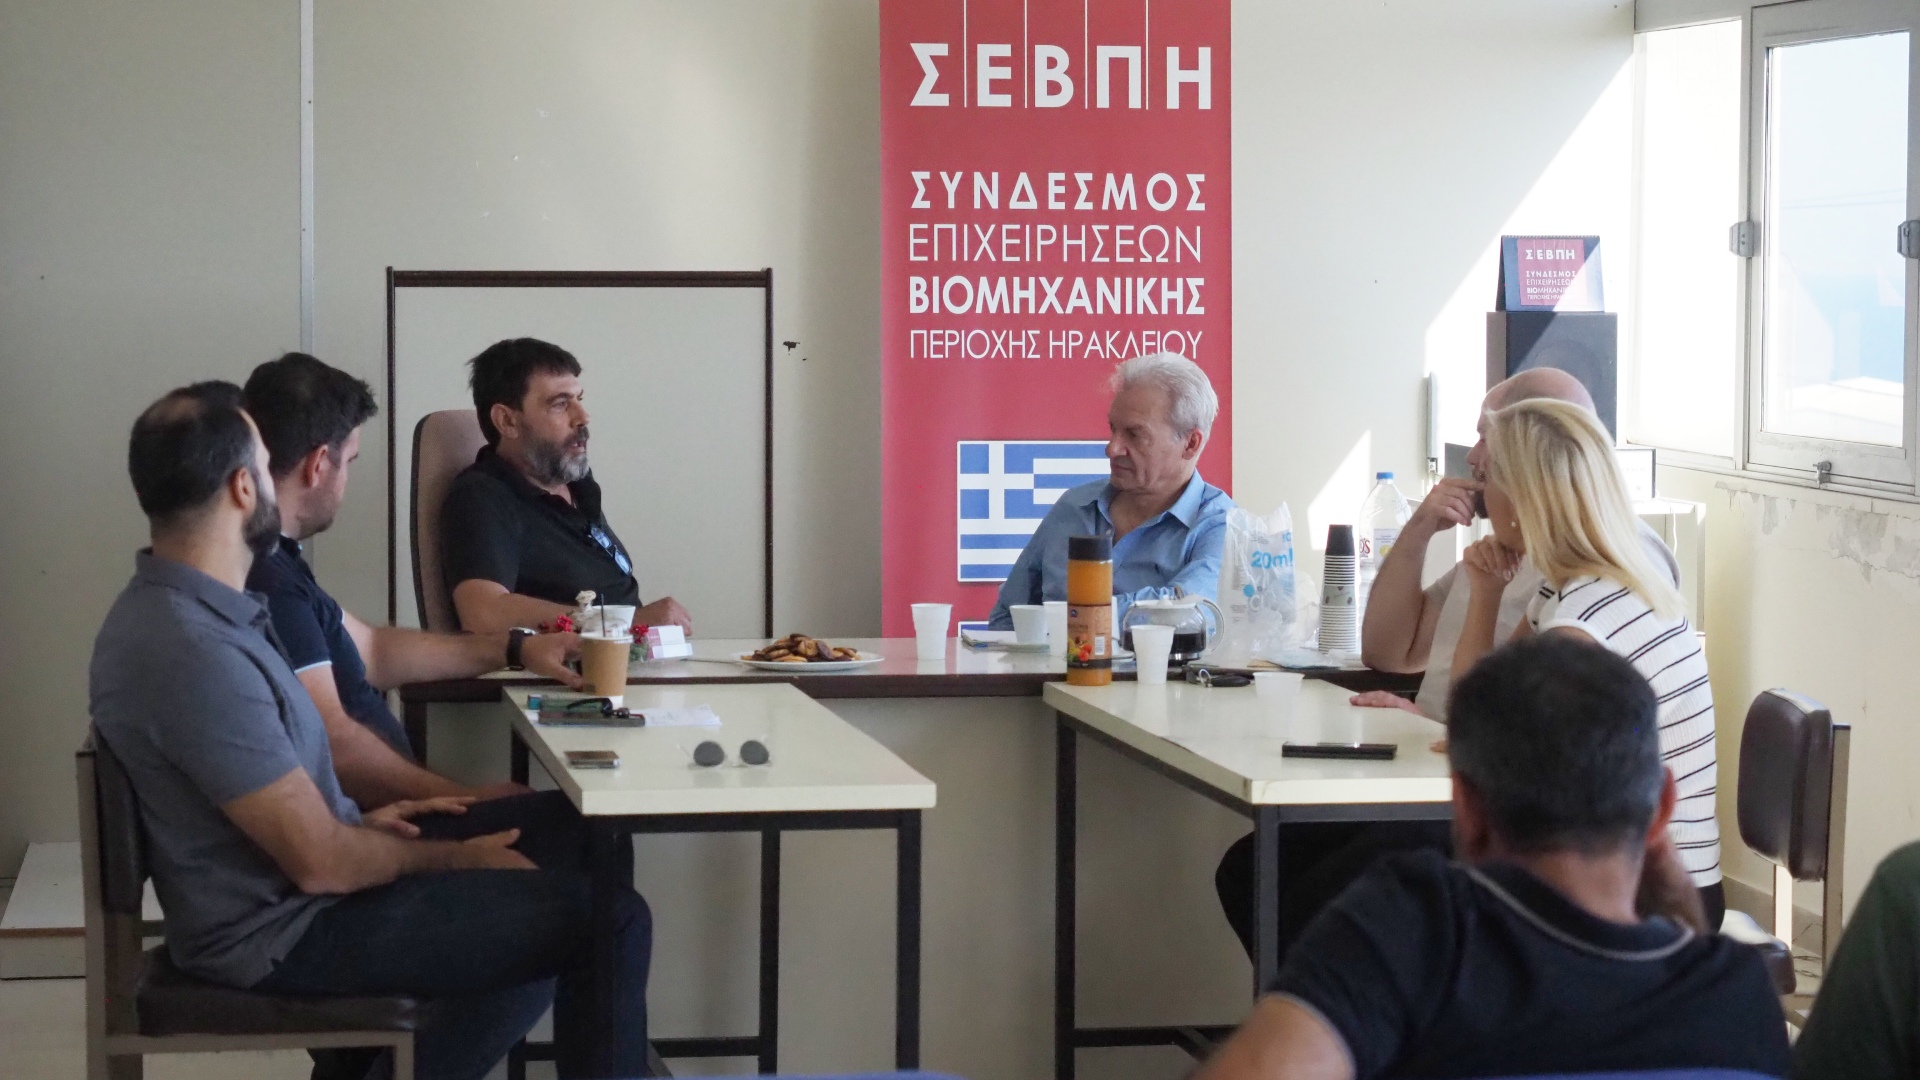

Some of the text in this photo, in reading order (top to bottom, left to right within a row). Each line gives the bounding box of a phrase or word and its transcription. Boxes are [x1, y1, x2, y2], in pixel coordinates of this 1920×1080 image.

[910, 43, 1211, 110] ΣΕΒΠΗ
[912, 172, 1205, 211] ΣΥΝΔΕΣΜΟΣ
[910, 224, 1200, 262] ΕΠΙΧΕΙΡΗΣΕΩΝ
[1525, 249, 1575, 260] ΣΕΒΠΗ
[1526, 270, 1576, 278] ΣΥΝΔΕΣΜΟΣ
[910, 276, 1204, 314] ΒΙΟΜΗΧΑΝΙΚΗΣ
[911, 330, 1203, 359] ΠΕΡΙΟΧΗΣ ΗΡΑΚΛΕΙΟΥ
